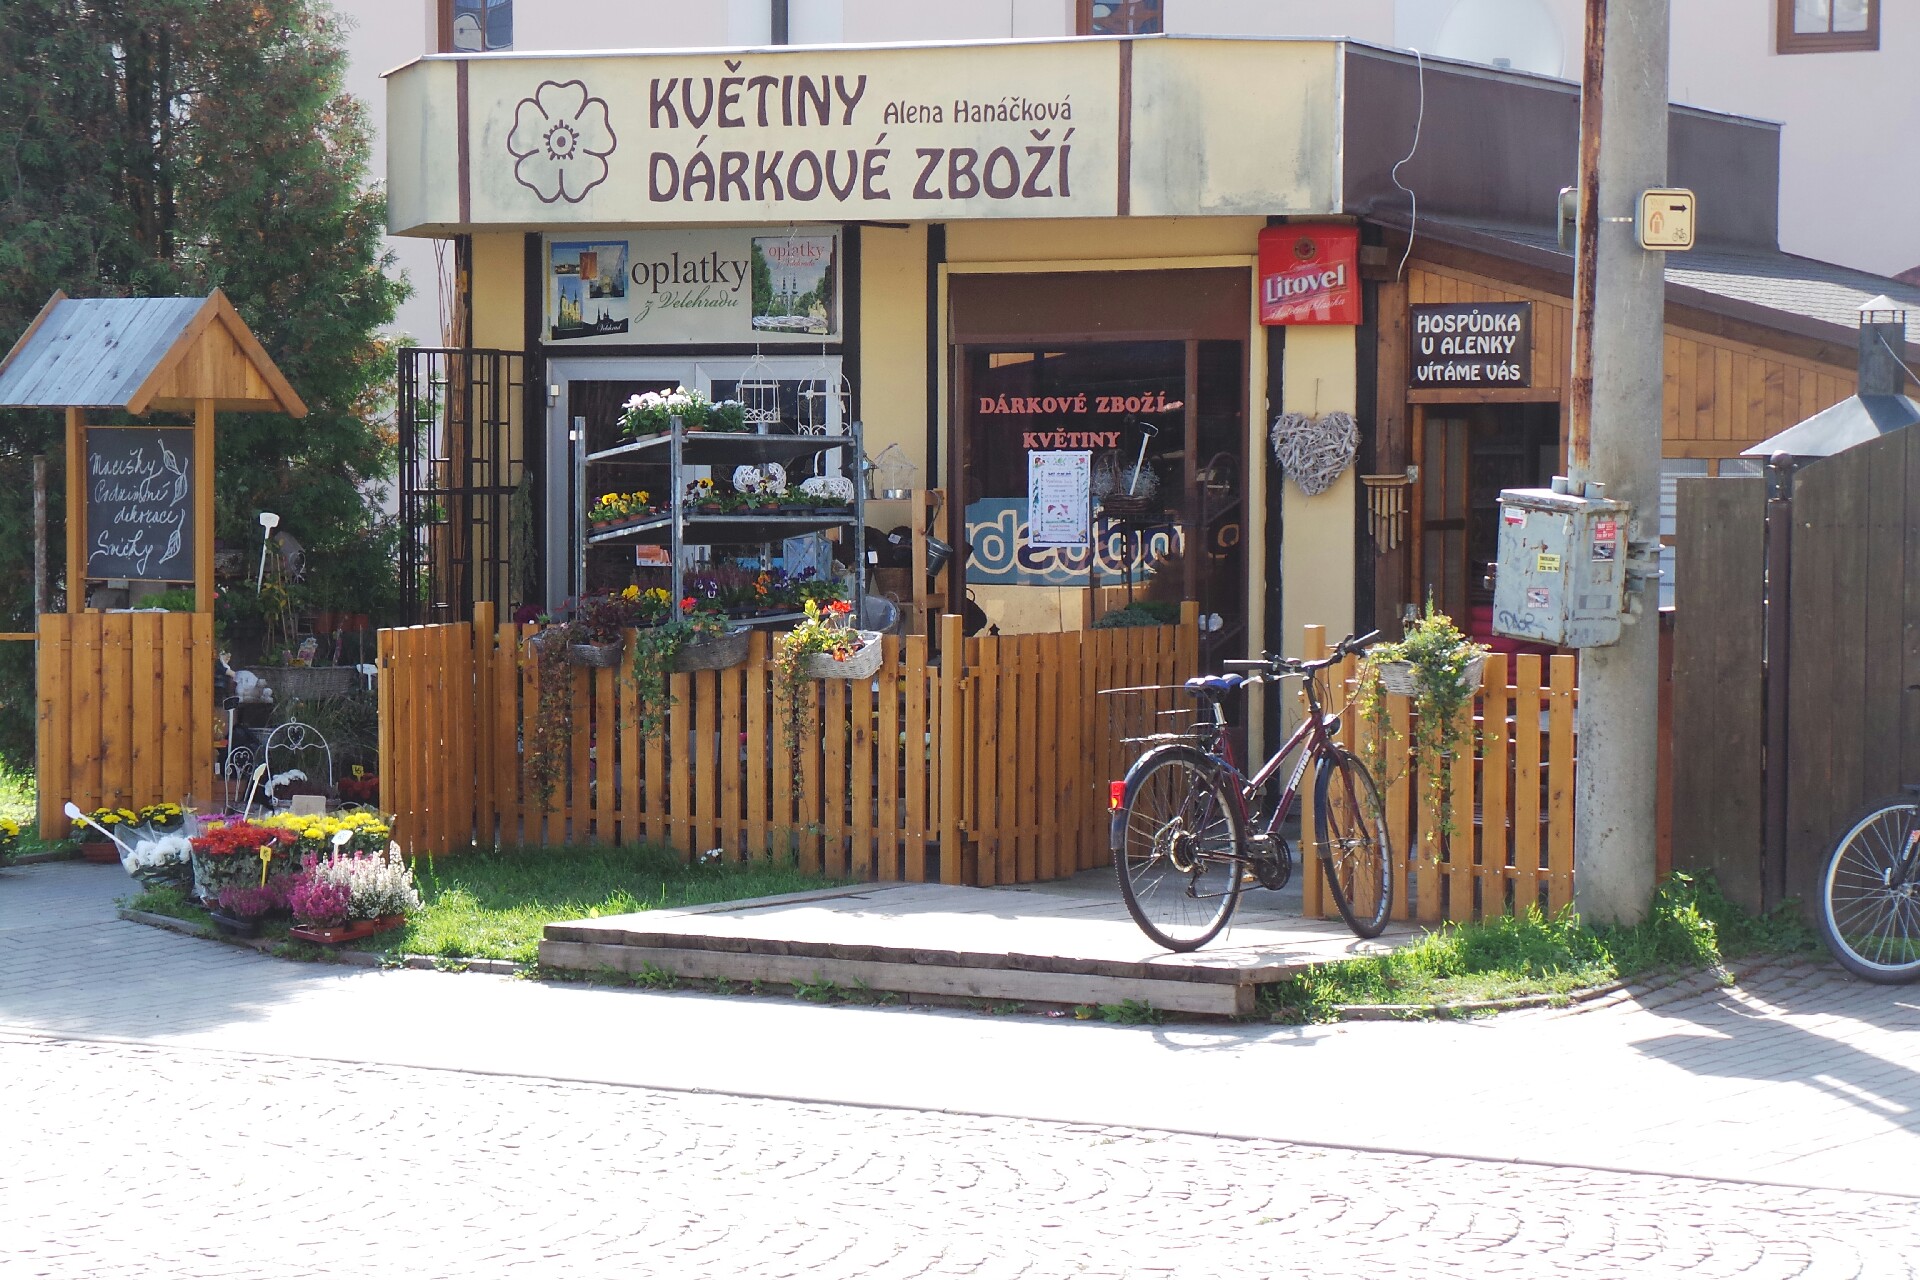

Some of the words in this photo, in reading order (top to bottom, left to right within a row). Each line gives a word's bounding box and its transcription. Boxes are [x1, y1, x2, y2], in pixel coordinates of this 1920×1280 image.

[650, 60, 868, 129] KVĚTINY
[883, 101, 943, 125] Alena
[954, 95, 1072, 125] Hanáčková
[648, 132, 891, 202] DÁRKOVÉ
[912, 127, 1077, 201] ZBOŽÍ
[768, 241, 825, 261] oplatky
[631, 251, 749, 293] oplatky
[1266, 264, 1345, 303] Litovel
[658, 285, 739, 309] Velehradu
[1416, 309, 1521, 333] HOSPŮDKA
[1421, 337, 1434, 355] U
[1440, 335, 1516, 355] ALENKY
[1416, 361, 1481, 381] VÍTÁME
[1486, 360, 1521, 381] VÁS
[979, 393, 1088, 414] DÁRKOVÉ
[1096, 391, 1166, 413] ZBOŽÍ
[1022, 427, 1121, 449] KVĚTINY
